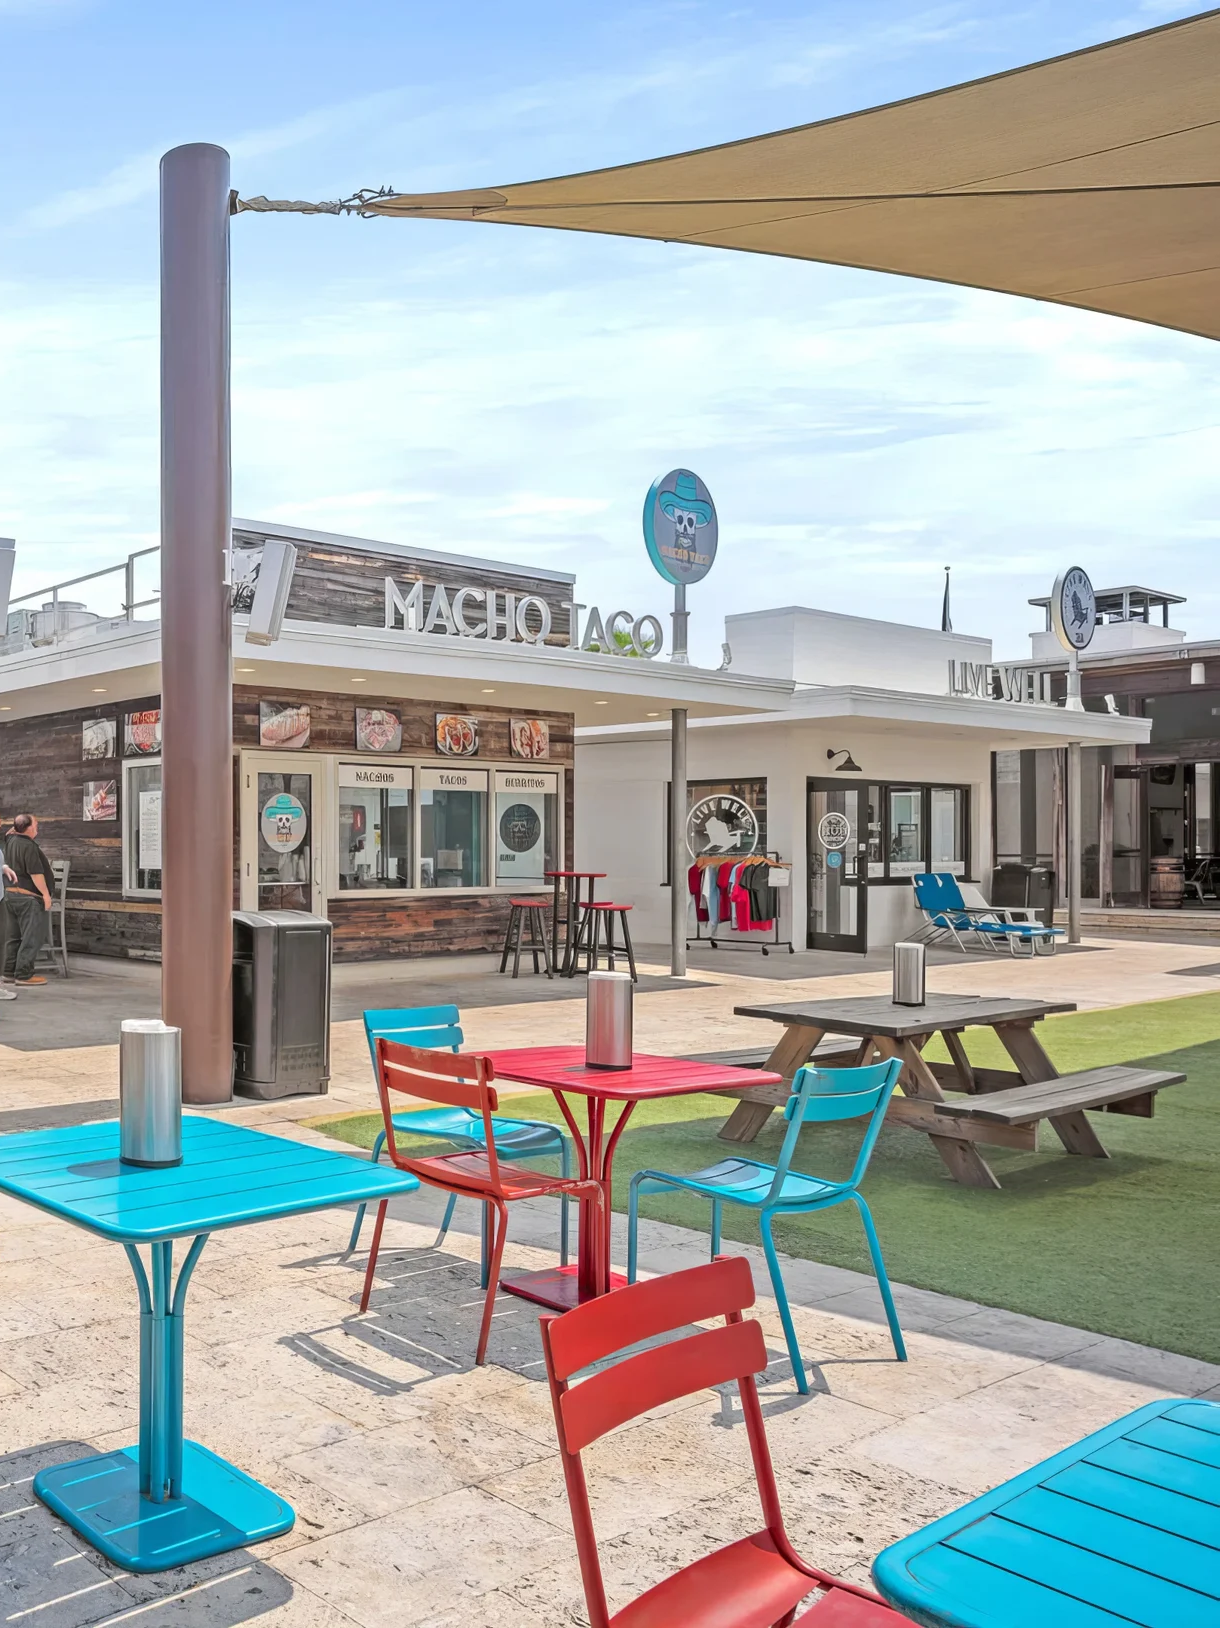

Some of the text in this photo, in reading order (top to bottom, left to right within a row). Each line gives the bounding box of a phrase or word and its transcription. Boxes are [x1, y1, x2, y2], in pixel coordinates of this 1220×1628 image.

[384, 576, 664, 659] MACHO TACO
[948, 659, 1059, 706] LIVE WELL
[439, 774, 467, 785] TACOS
[691, 798, 753, 828] LIVE WELL
